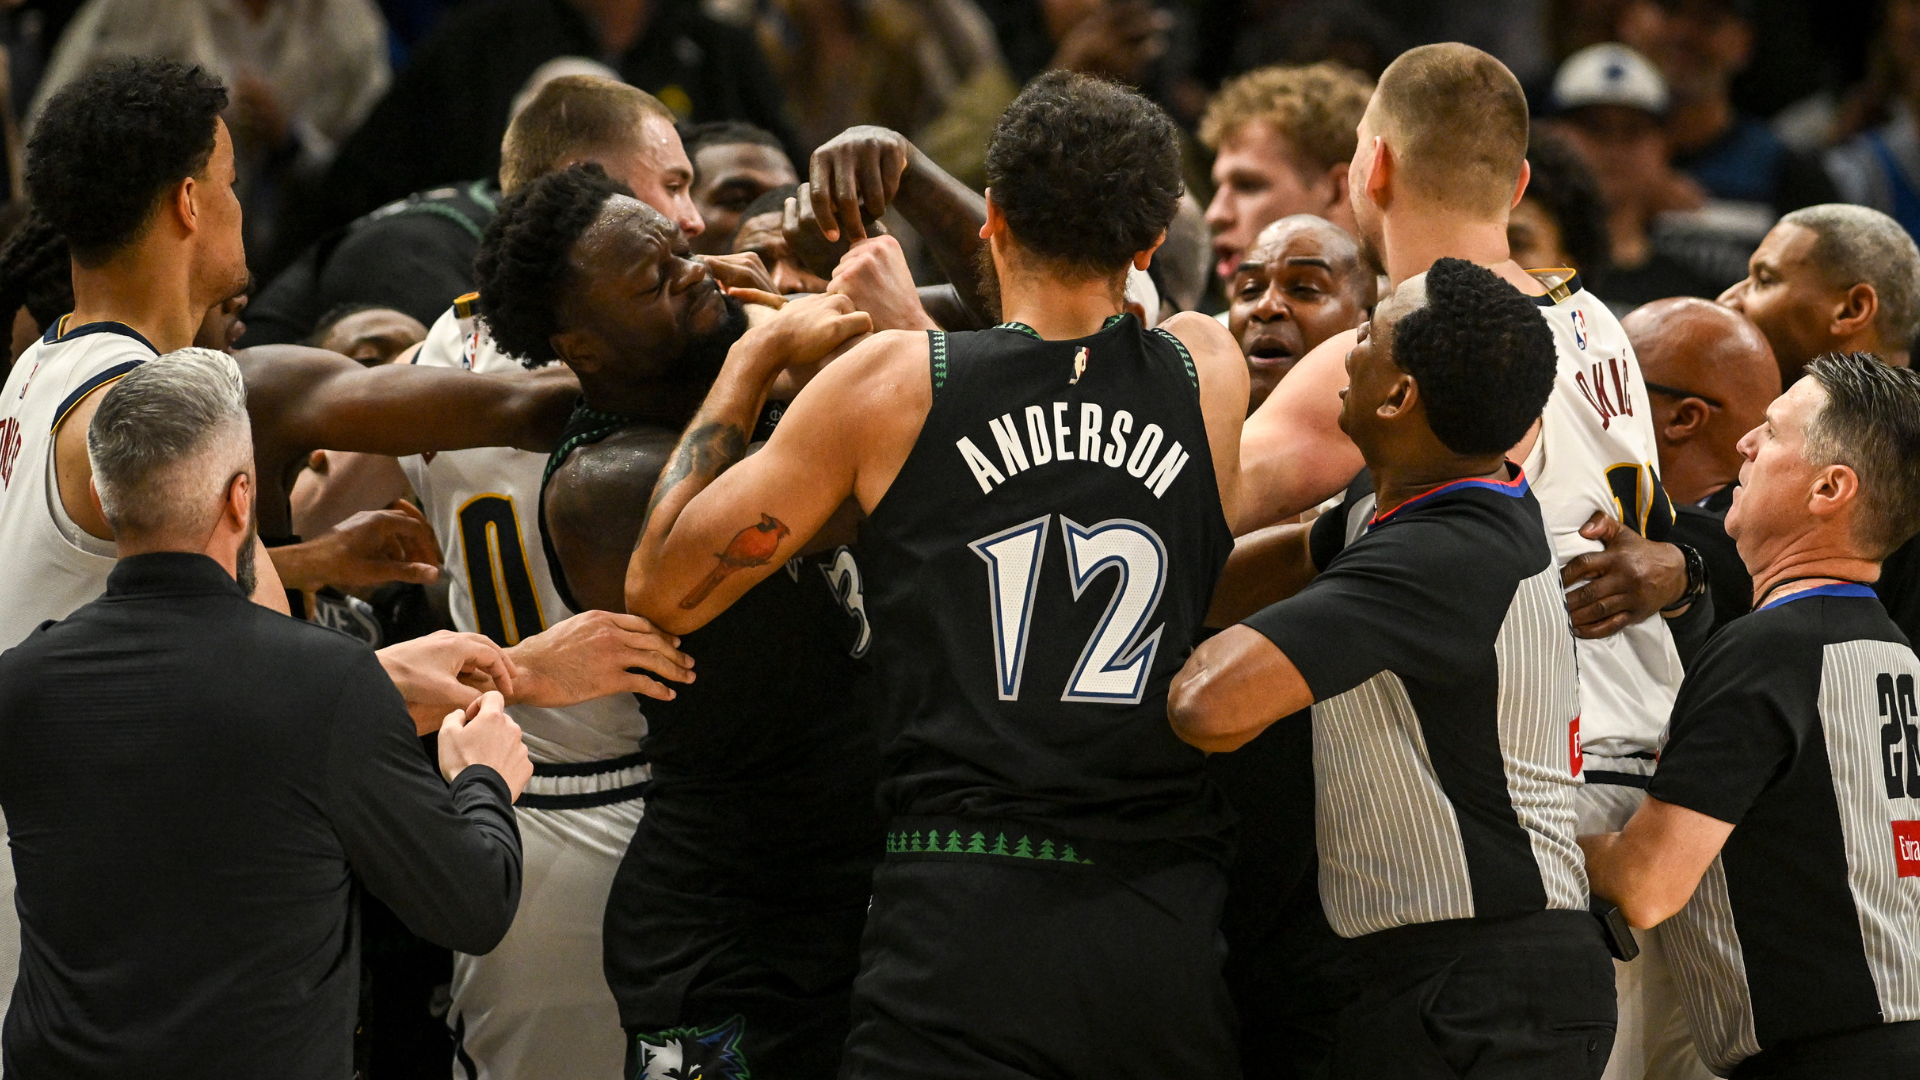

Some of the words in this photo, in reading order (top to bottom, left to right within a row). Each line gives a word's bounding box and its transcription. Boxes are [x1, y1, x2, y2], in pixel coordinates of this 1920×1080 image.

[956, 402, 1190, 499] ANDERSON
[457, 492, 547, 648] 0
[967, 514, 1168, 704] 12
[1876, 673, 1920, 799] 26
